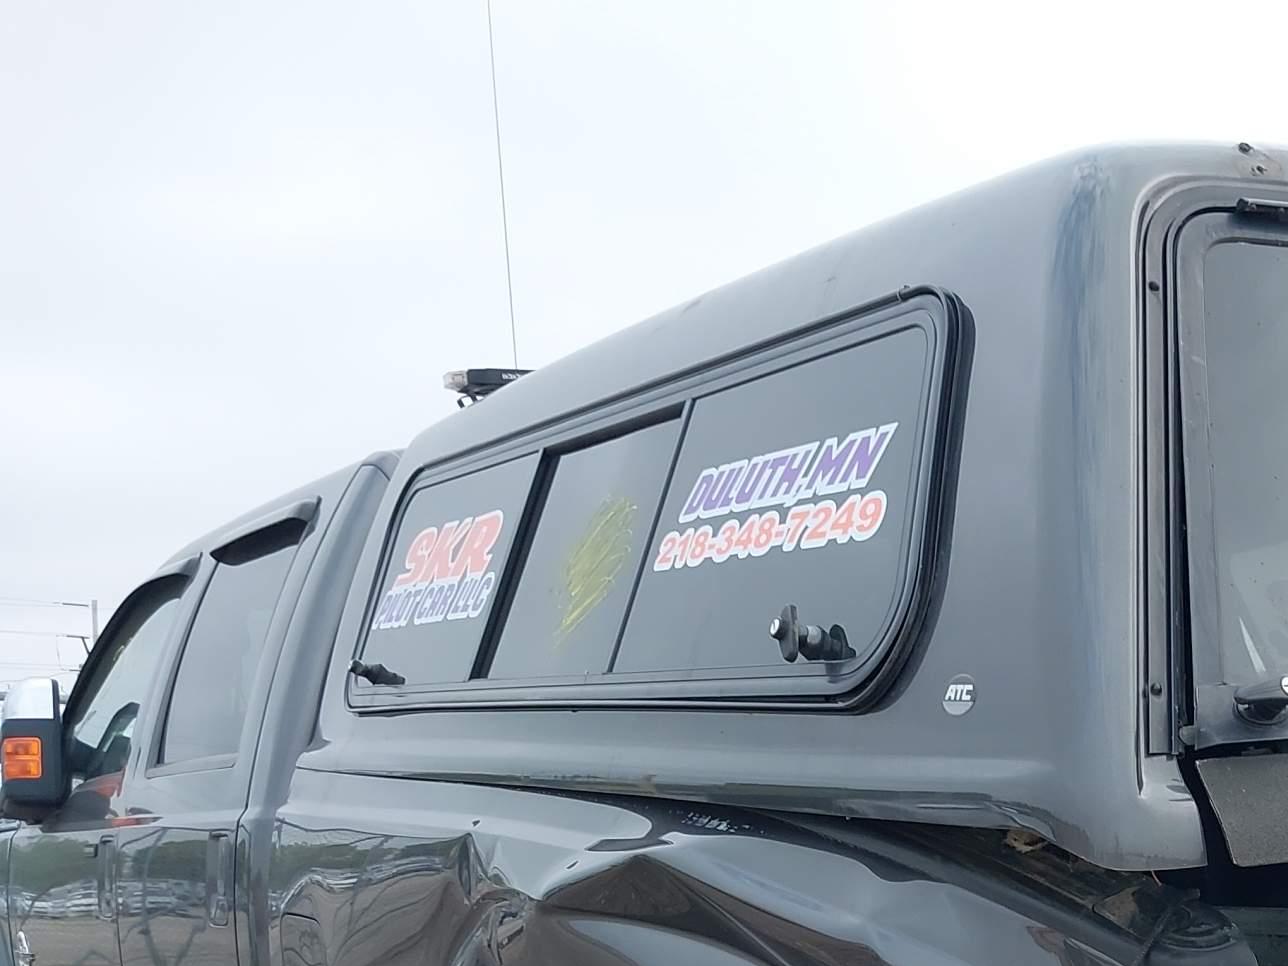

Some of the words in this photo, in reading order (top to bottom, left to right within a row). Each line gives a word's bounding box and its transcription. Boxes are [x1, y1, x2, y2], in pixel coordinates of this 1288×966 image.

[391, 510, 503, 591] SKR
[654, 490, 887, 571] 218-348-7249
[372, 587, 424, 629] PILOT
[414, 581, 458, 624] CAR
[447, 572, 495, 619] LLC
[945, 685, 973, 700] ATC
